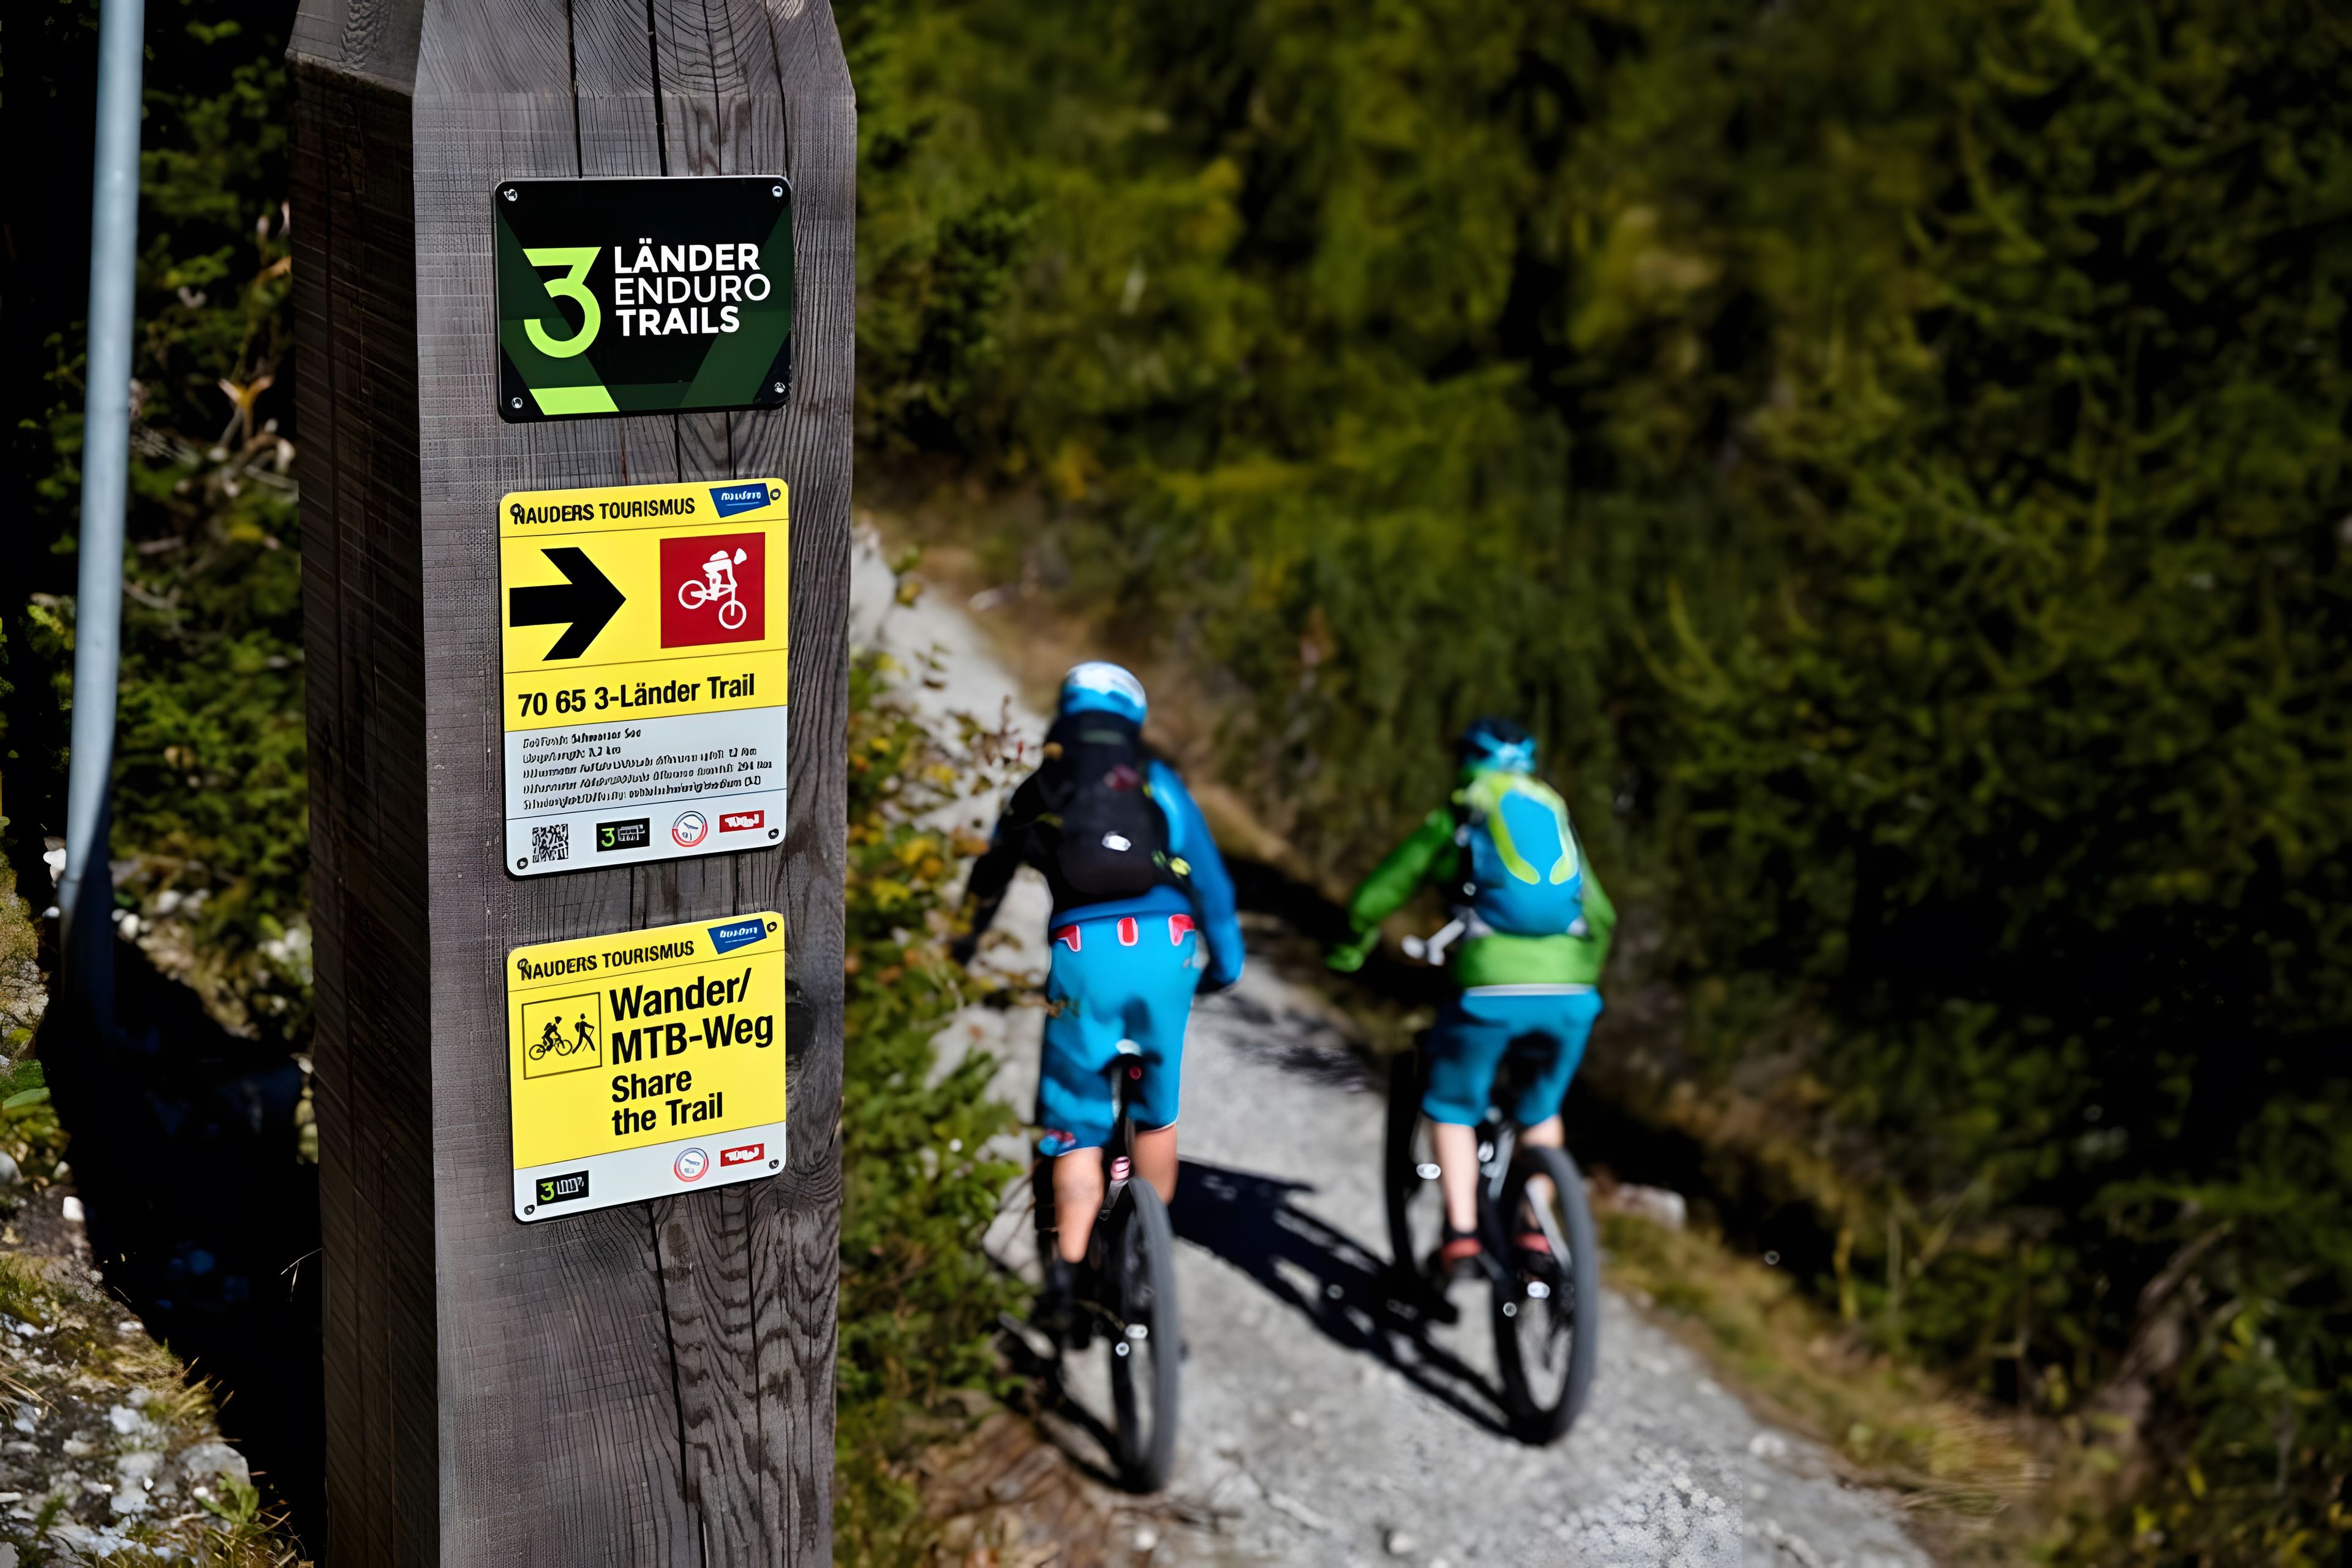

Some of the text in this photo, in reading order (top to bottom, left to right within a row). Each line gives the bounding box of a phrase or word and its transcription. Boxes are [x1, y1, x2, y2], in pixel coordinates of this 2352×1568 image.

[614, 238, 761, 274] LÄNDER
[522, 246, 601, 358] 3
[614, 273, 771, 306] ENDURO
[615, 305, 740, 337] TRAILS
[513, 497, 695, 525] NAUDERS TOURISMUS
[518, 673, 755, 717] 70 65 3-Länder Trail
[519, 940, 695, 981] NAUDERS TOURISMUS
[609, 967, 752, 1022] Wander/
[612, 1013, 774, 1065] MTB-Weg
[611, 1070, 692, 1103] Share
[611, 1091, 723, 1136] the Trail
